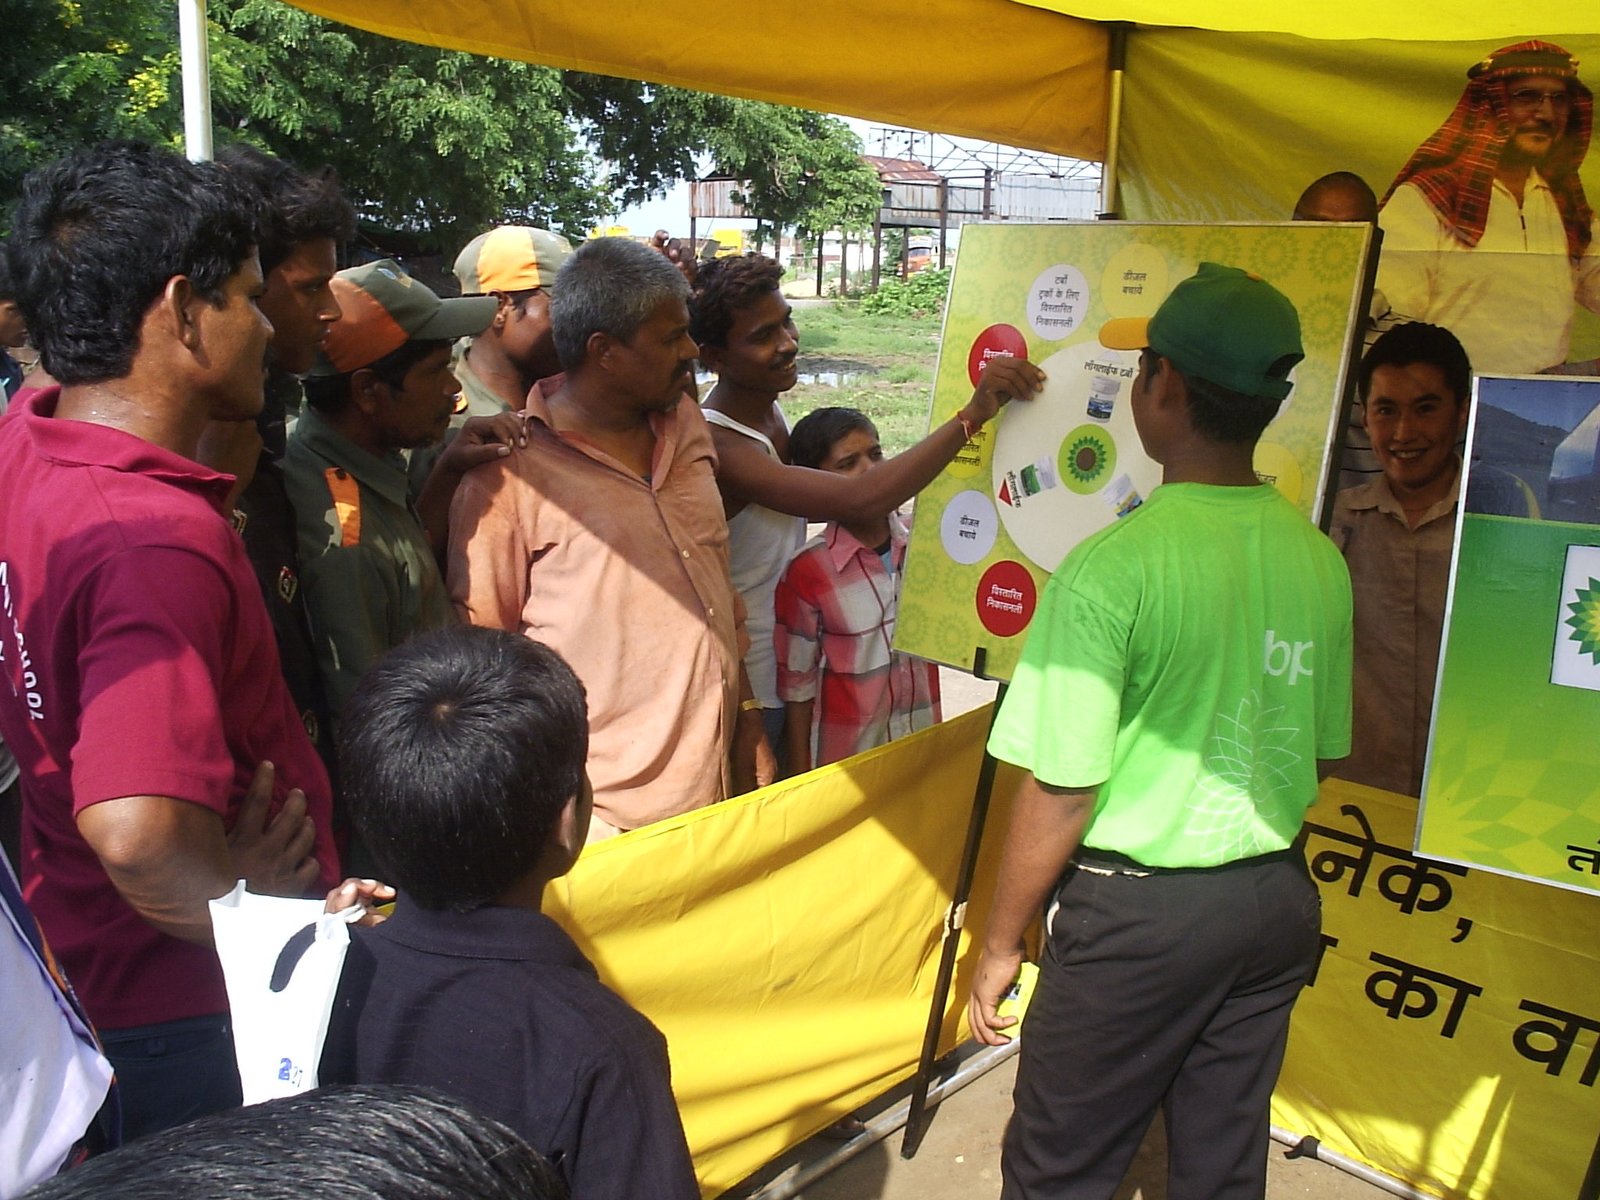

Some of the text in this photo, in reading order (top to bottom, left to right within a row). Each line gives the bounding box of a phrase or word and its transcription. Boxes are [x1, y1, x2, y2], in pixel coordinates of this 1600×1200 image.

[1123, 269, 1147, 281] डीजल
[1065, 288, 1081, 301] लिए
[1040, 301, 1073, 314] विस्तारित
[960, 514, 980, 528] डीजल
[991, 583, 1024, 601] विस्तारित
[1263, 629, 1314, 686] bp
[1300, 804, 1474, 943] नेक,
[1365, 951, 1483, 1039] का
